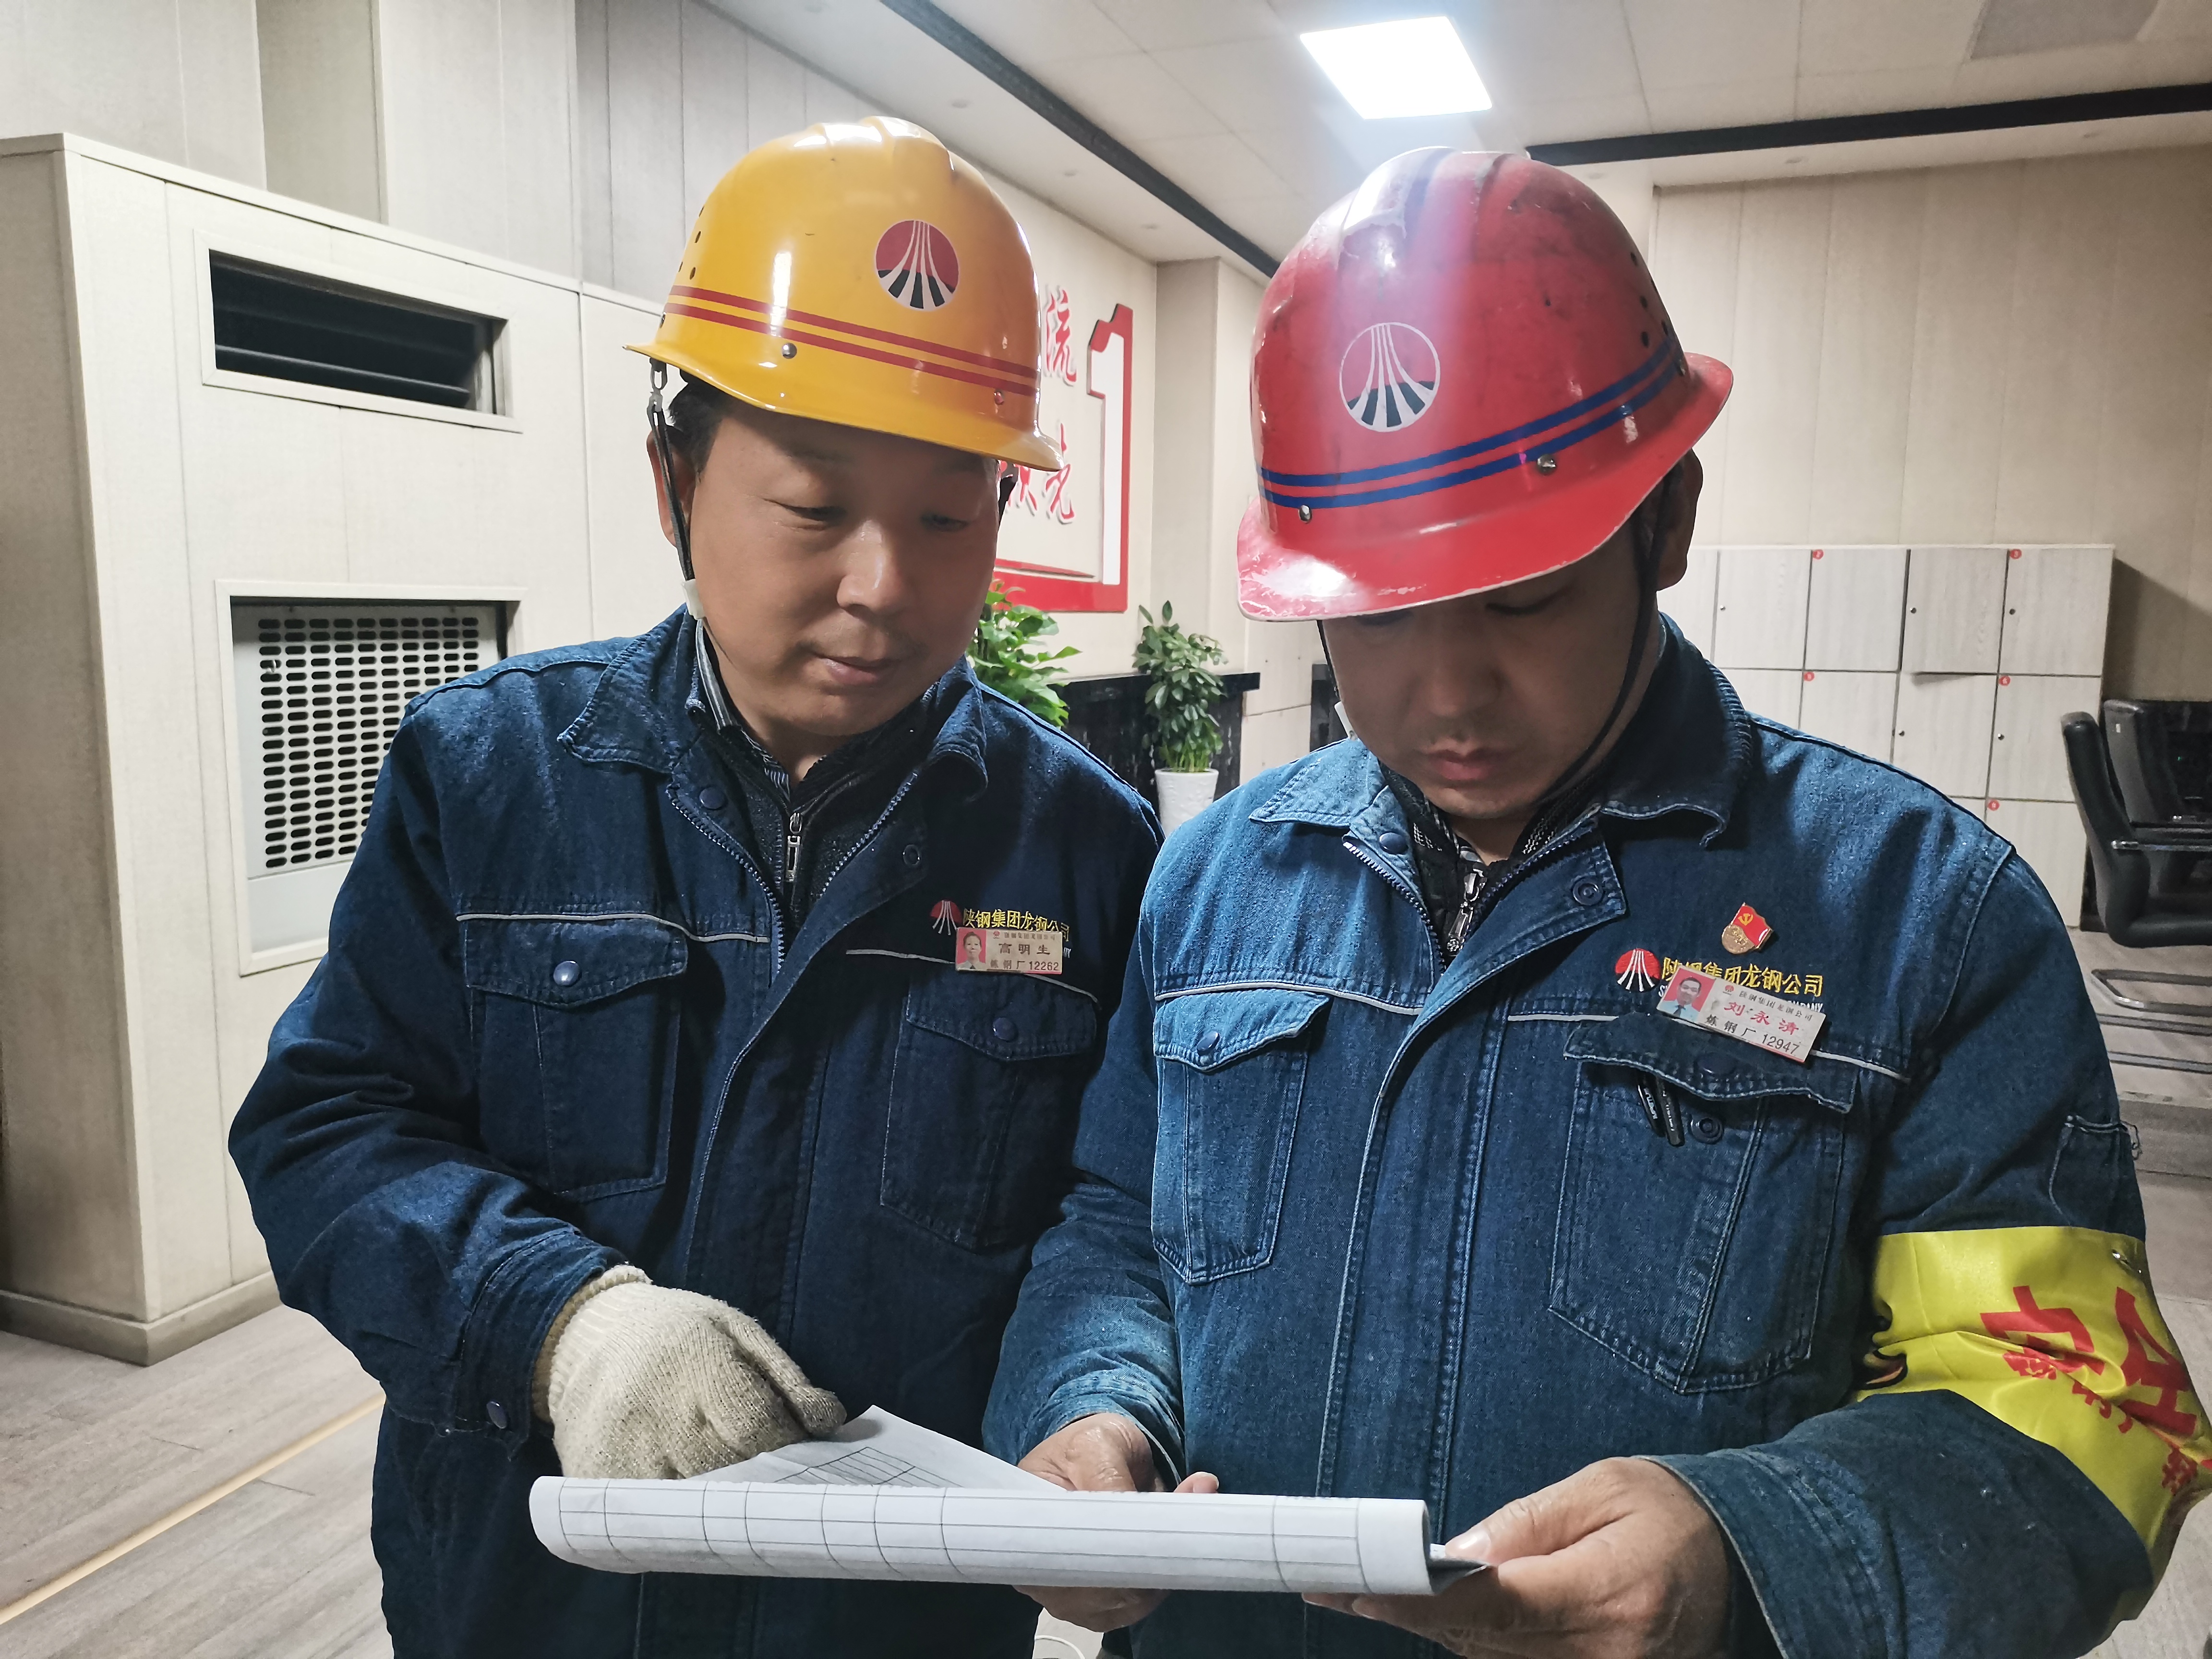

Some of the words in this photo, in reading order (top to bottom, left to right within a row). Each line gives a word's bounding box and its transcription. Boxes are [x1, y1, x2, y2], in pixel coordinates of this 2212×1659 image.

[1046, 289, 1077, 383] 流
[998, 942, 1051, 956] 高明生
[1028, 961, 1059, 971] 12262
[1761, 1033, 1801, 1056] 12947
